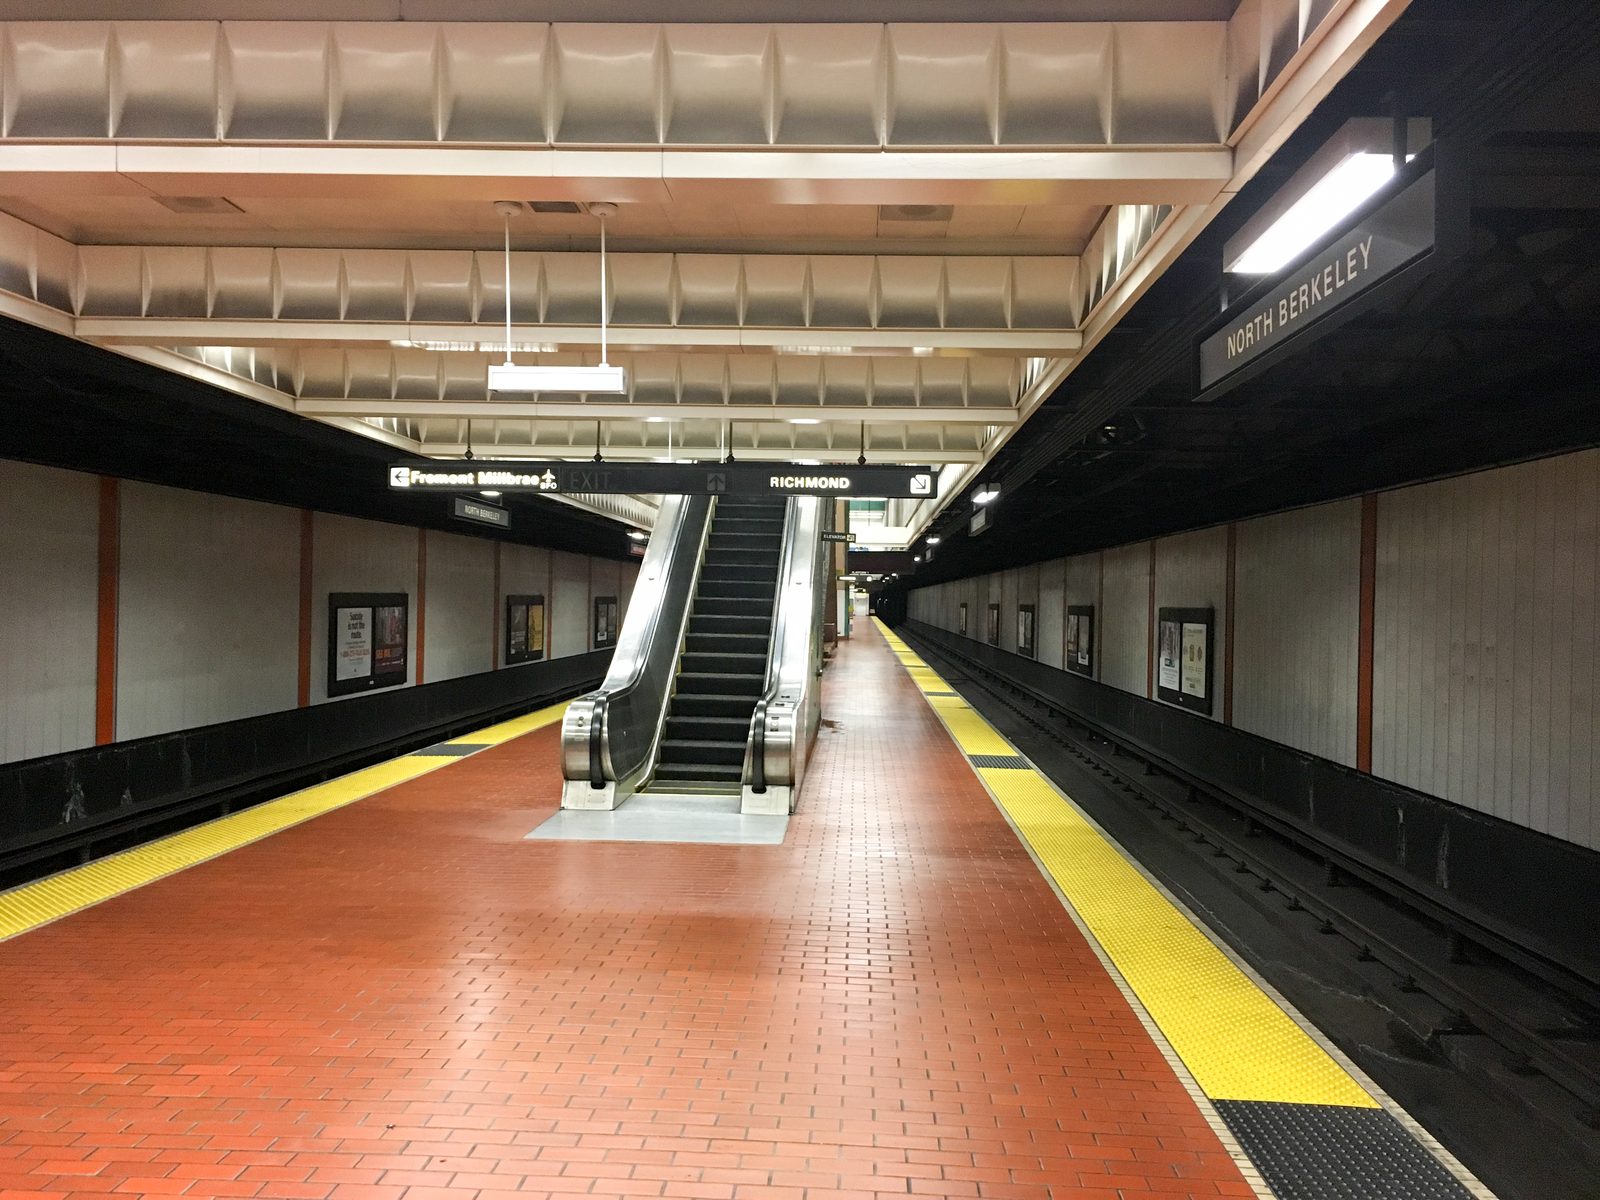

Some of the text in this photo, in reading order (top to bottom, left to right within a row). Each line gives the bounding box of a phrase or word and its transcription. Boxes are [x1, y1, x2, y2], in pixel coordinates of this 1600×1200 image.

[1227, 235, 1373, 360] NORTH BERKELEY
[410, 470, 540, 486] Fremont Millbrae
[540, 482, 557, 490] SFO
[570, 471, 612, 490] EXIT
[769, 476, 850, 489] RICHMOND
